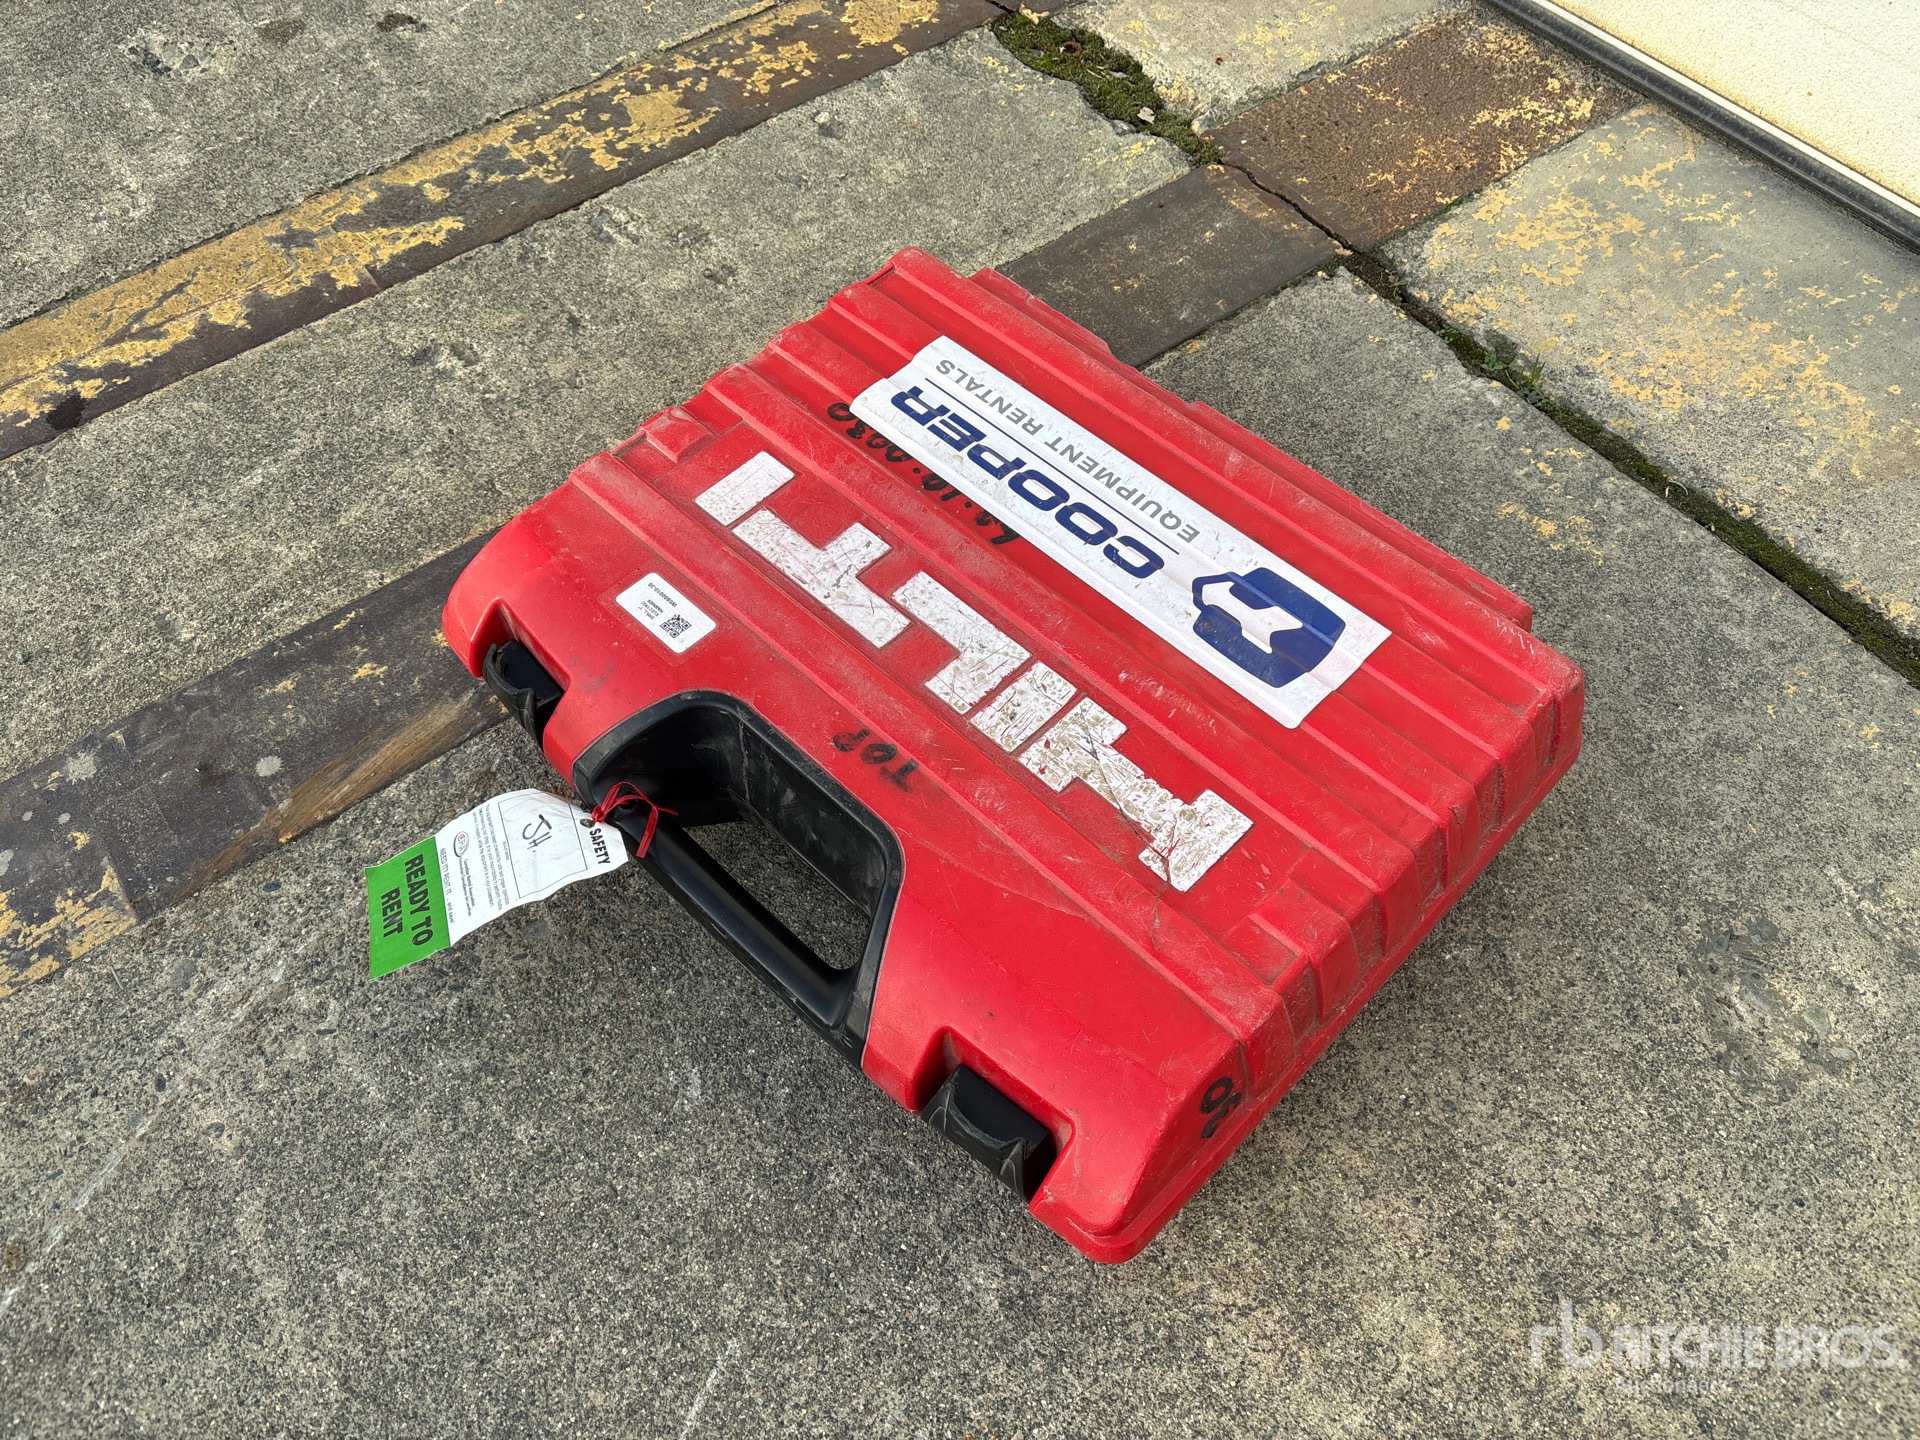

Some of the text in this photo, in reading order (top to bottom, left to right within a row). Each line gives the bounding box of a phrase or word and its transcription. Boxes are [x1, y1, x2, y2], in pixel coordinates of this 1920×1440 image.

[891, 386, 1165, 579] COOPER
[936, 359, 1201, 543] EQUIPMENT RENTALS
[695, 451, 1253, 892] HILTI
[832, 729, 919, 792] TOP
[589, 828, 611, 865] SAFETY
[381, 887, 404, 938] RENT
[404, 854, 434, 946] READY TO
